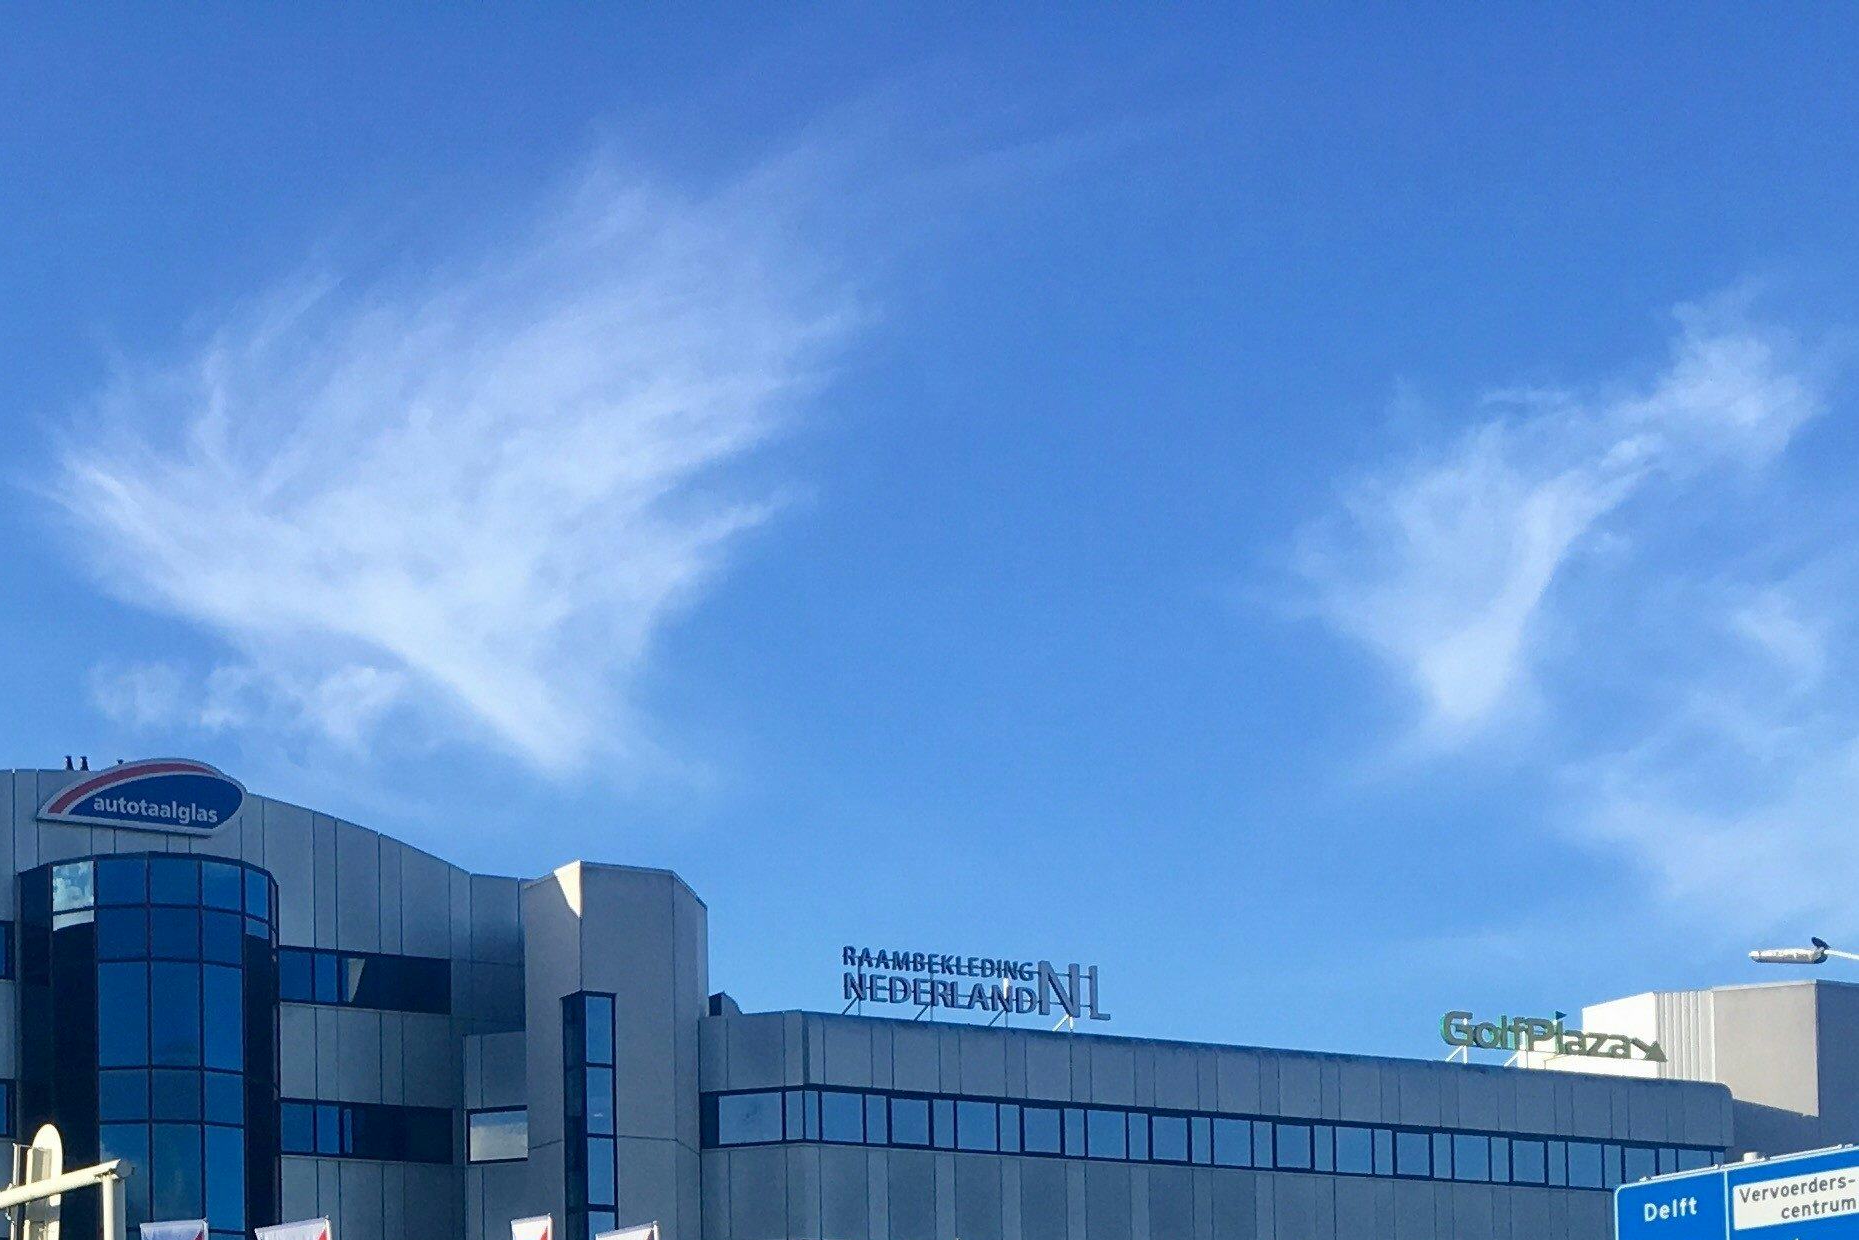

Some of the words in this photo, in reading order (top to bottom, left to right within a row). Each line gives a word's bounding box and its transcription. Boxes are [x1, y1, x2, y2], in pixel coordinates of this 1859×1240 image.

[93, 796, 218, 825] autotaalglas
[842, 945, 1034, 981] RAAMBEKLEDING
[843, 972, 1038, 1014] NEDERLAND
[1440, 1010, 1632, 1059] GolfPlaza
[1739, 1175, 1855, 1204] Vervoerders-
[1643, 1196, 1698, 1223] Delft
[1781, 1197, 1857, 1219] centrum
